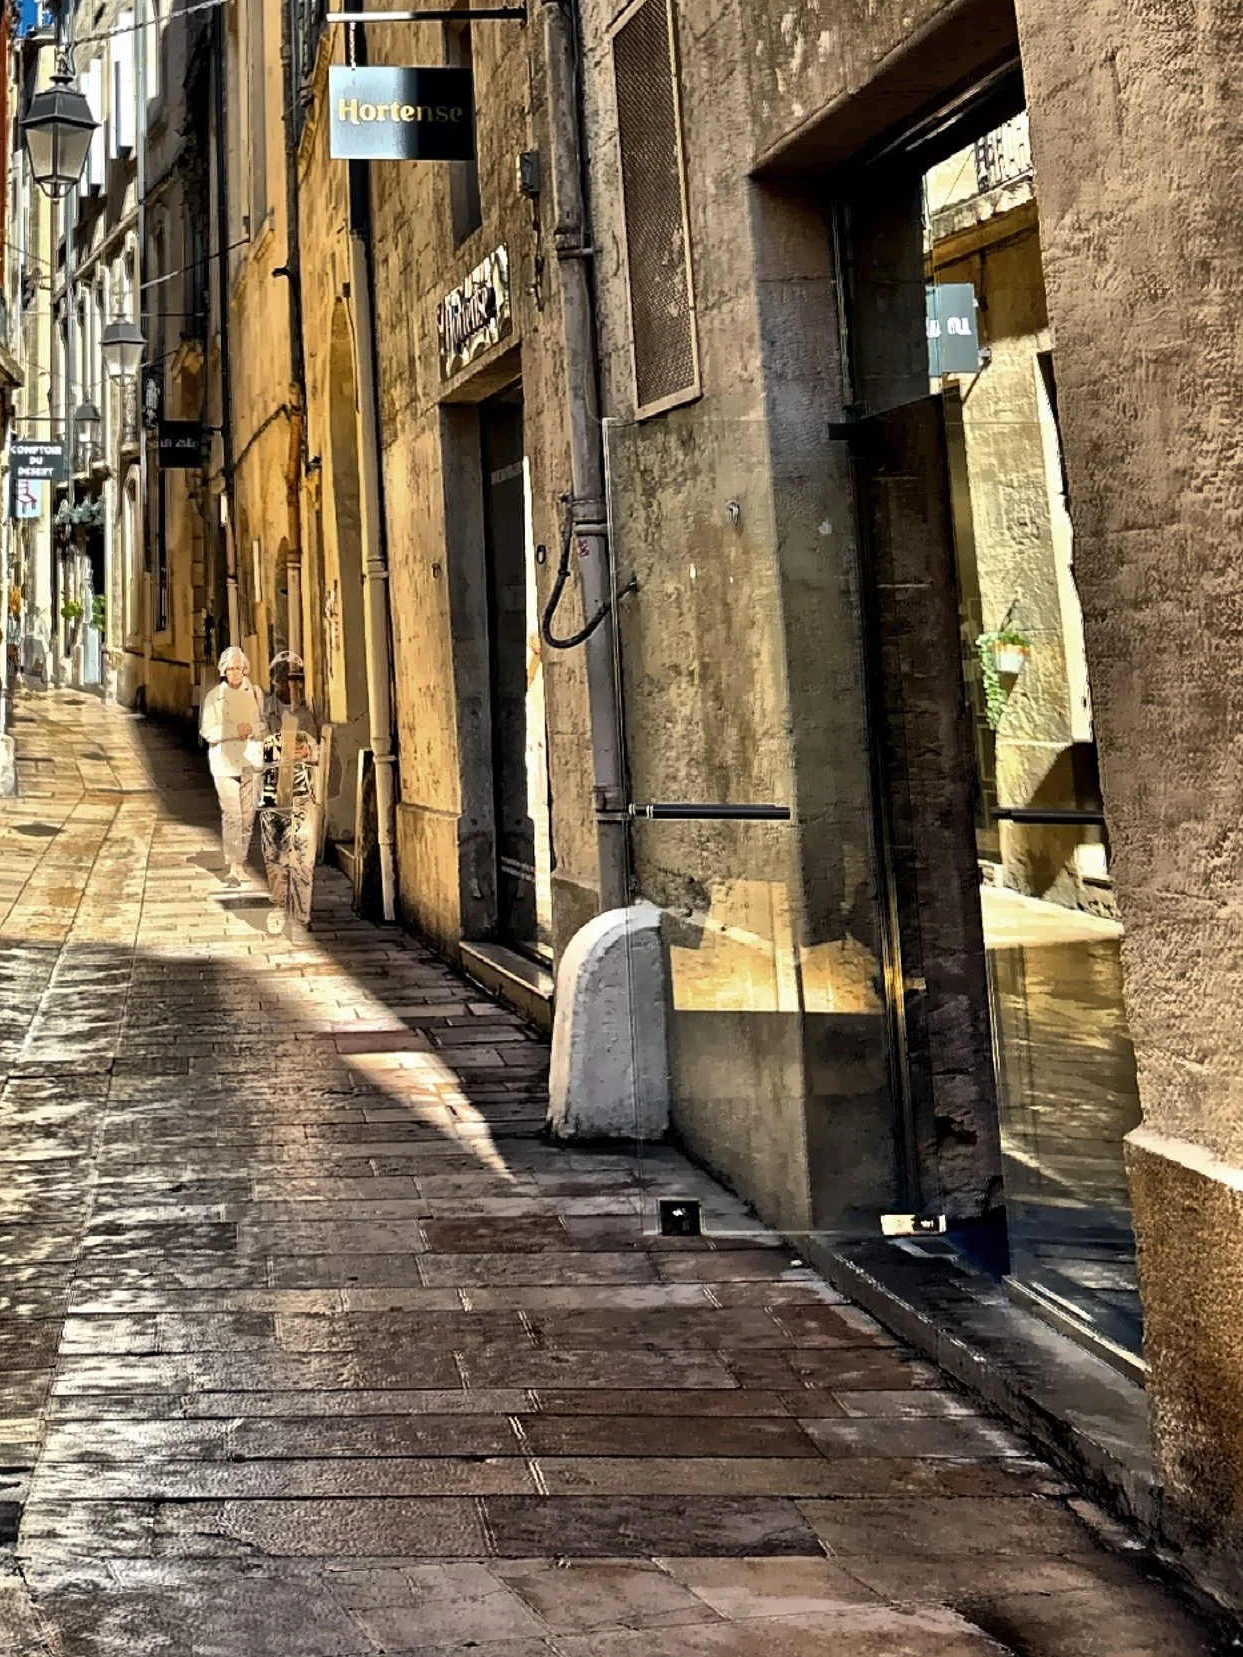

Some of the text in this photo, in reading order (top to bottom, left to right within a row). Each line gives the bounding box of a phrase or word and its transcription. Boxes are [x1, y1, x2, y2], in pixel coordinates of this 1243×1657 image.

[338, 98, 463, 125] Hortense
[10, 445, 62, 455] COMPTOIR
[29, 456, 43, 465] DU
